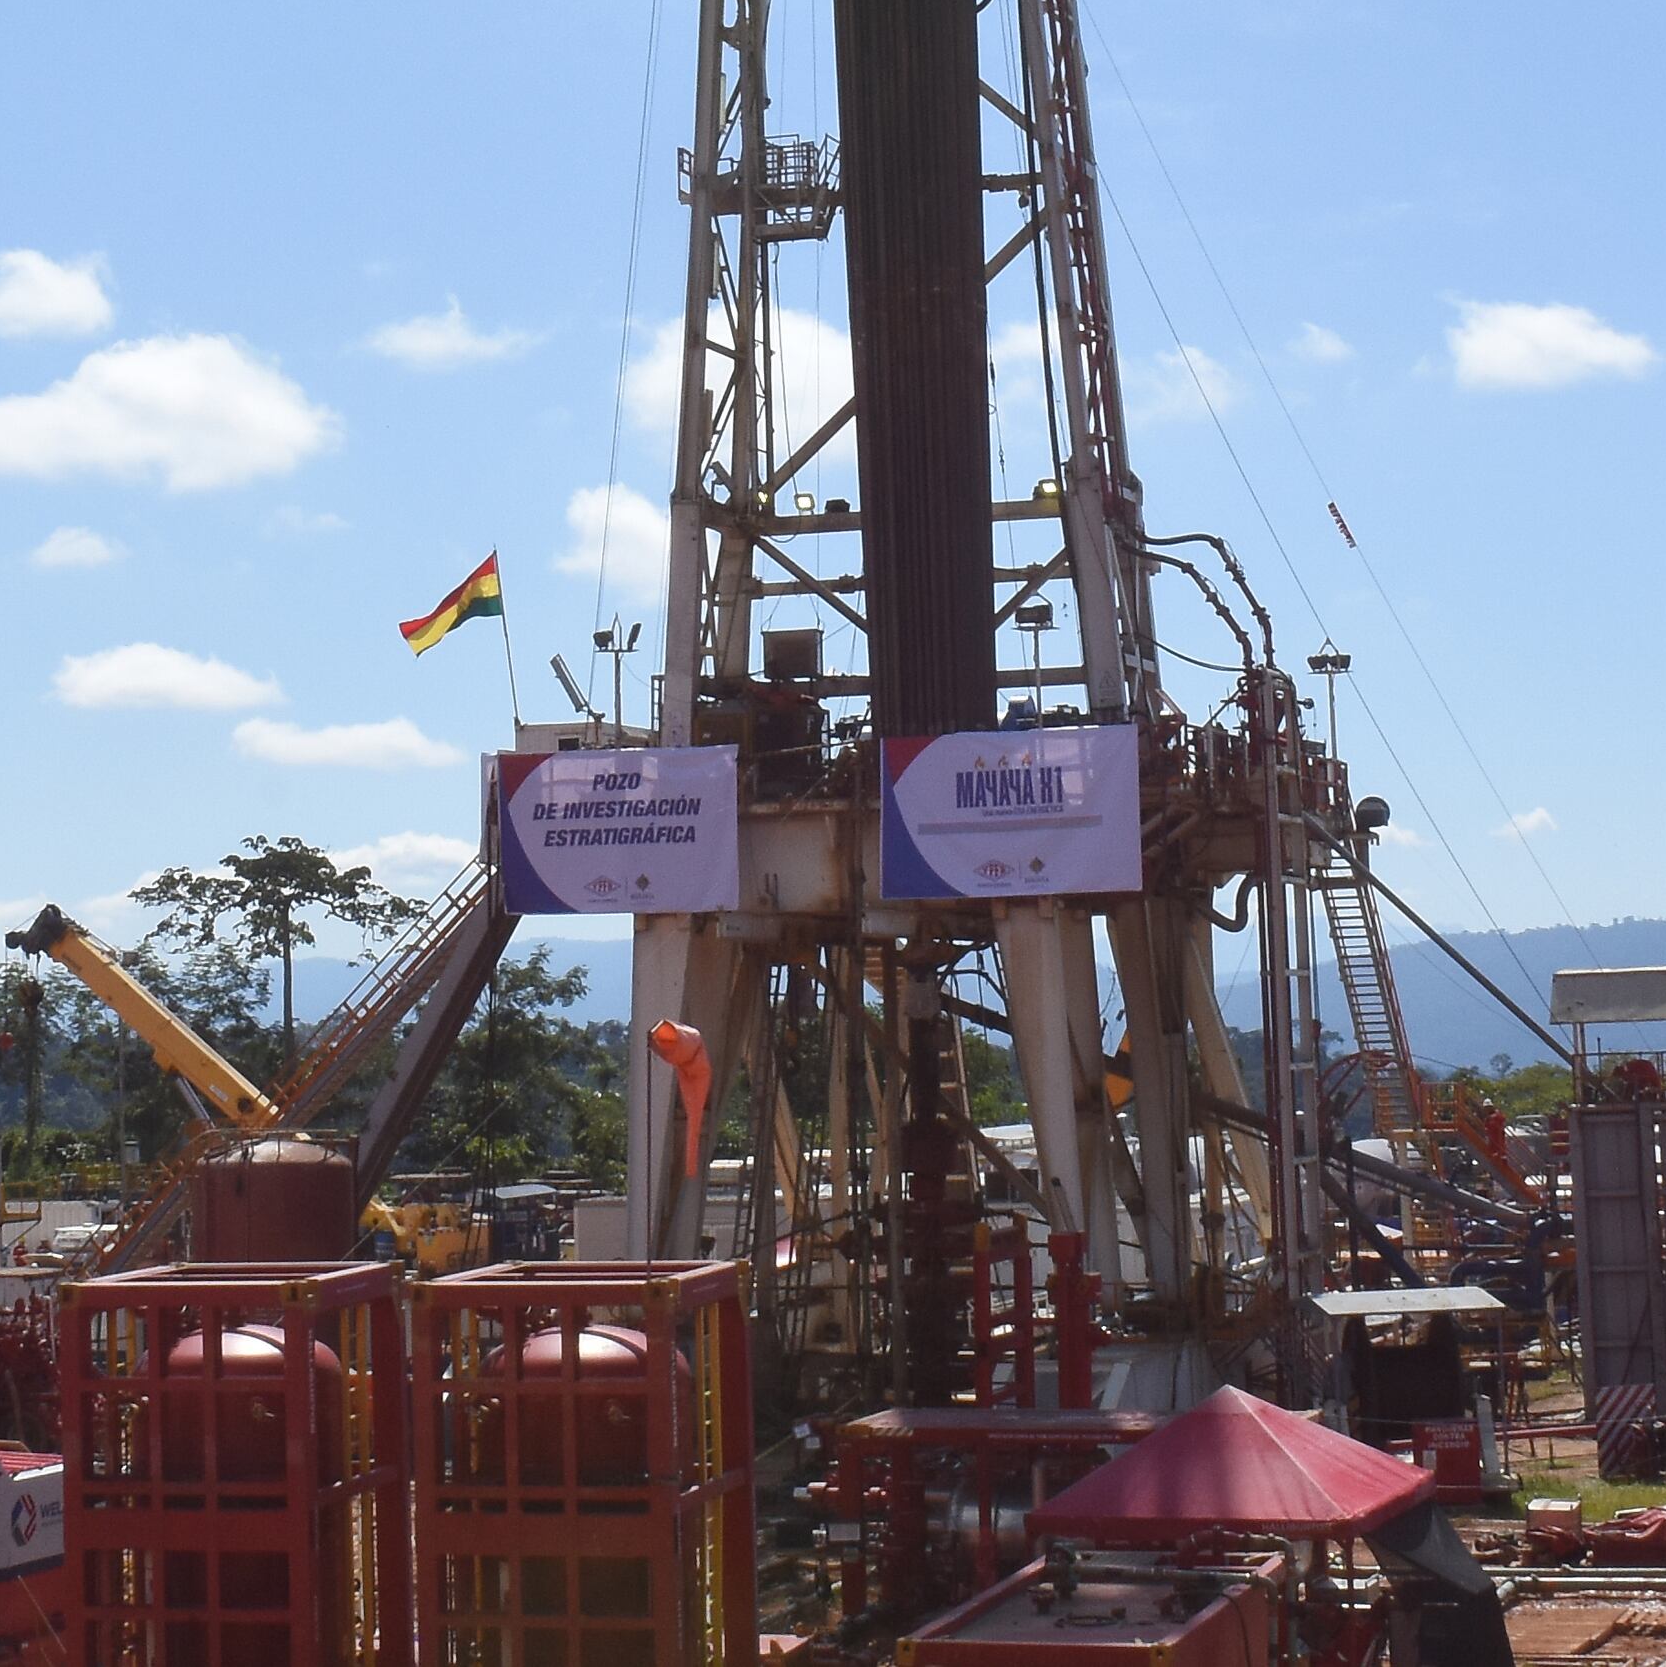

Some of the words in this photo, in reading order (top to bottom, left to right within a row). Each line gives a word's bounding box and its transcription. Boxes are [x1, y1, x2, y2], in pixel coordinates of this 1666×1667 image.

[592, 772, 642, 791] POZO
[956, 768, 1035, 808] MAYAYA
[1040, 766, 1063, 804] X1
[533, 802, 558, 821] DE
[563, 795, 702, 820] INVESTIGACIÓN
[544, 822, 696, 847] ESTRATIGRÁFICA
